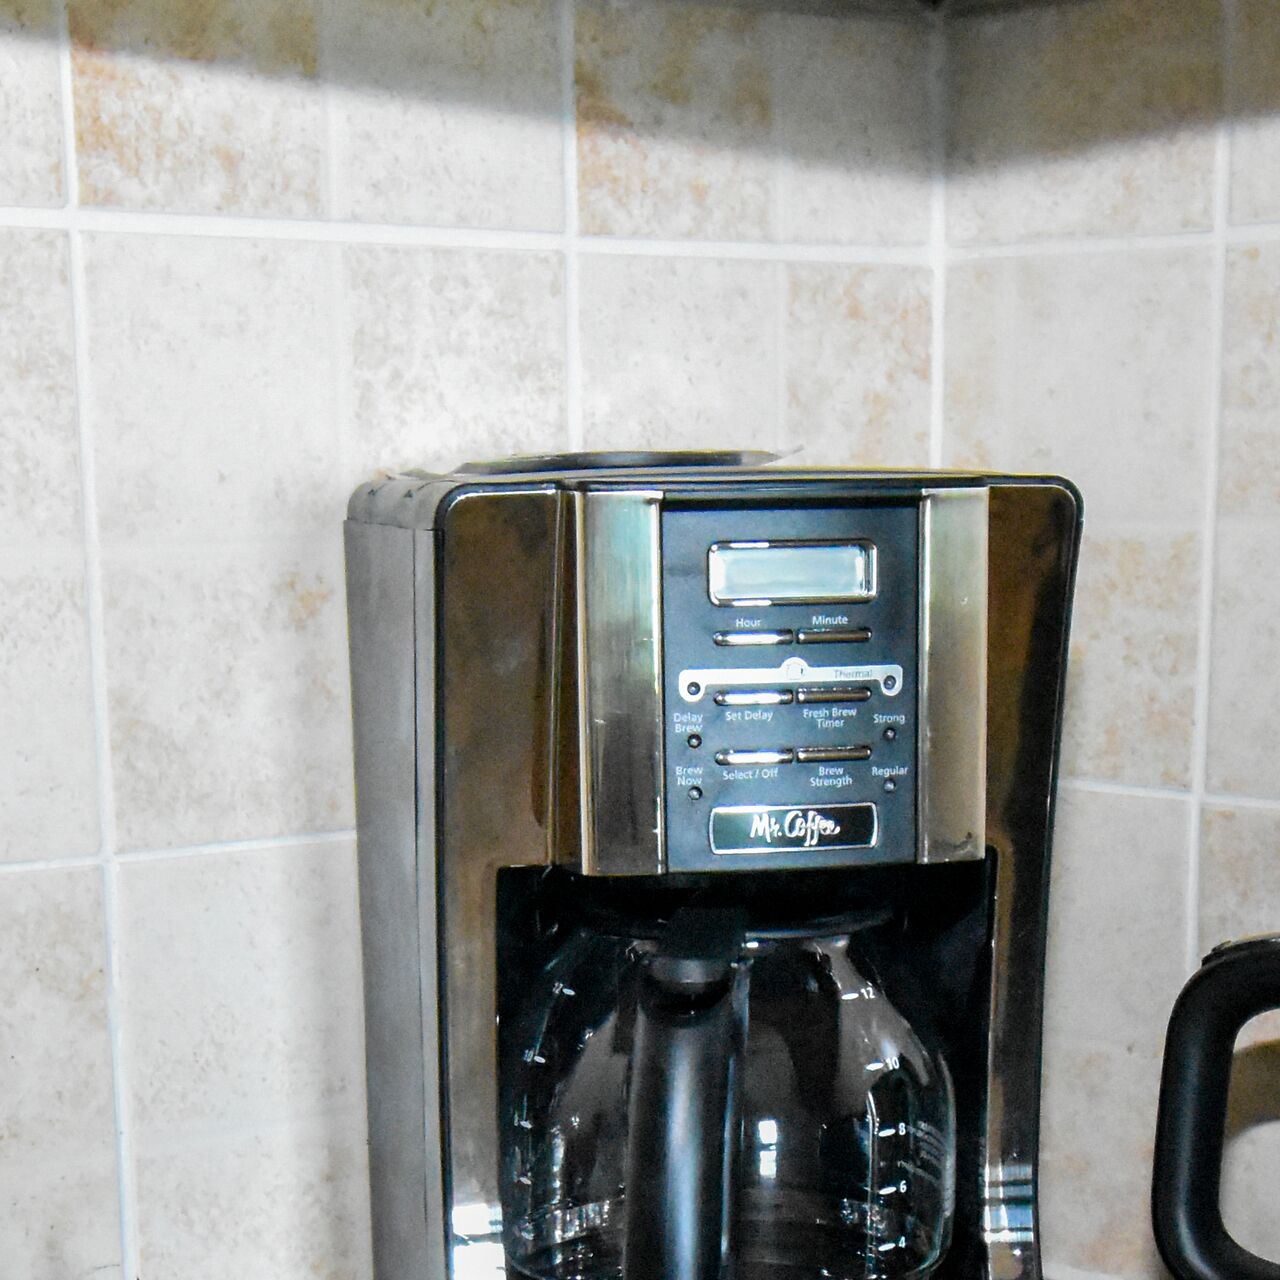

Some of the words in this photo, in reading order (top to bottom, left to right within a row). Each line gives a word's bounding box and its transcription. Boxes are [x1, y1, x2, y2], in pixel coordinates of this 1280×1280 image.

[735, 617, 761, 628] Hour
[812, 615, 848, 625] Minute
[833, 668, 872, 679] Thermal
[673, 712, 703, 724] Delay
[725, 710, 742, 721] Set
[744, 710, 774, 722] Delay
[803, 708, 830, 719] Fresh
[832, 707, 857, 718] Brew
[873, 713, 905, 725] Strong
[675, 723, 703, 733] Brew
[816, 717, 845, 729] Timer
[676, 766, 704, 776] Brew
[723, 770, 753, 780] Select
[761, 769, 778, 779] Off
[819, 766, 844, 776] Brew
[871, 766, 908, 777] Regular
[677, 776, 704, 786] Now
[809, 775, 853, 788] Strength
[750, 812, 783, 843] Mr.
[784, 811, 841, 846] Coffee
[861, 987, 875, 1000] 12
[886, 1056, 900, 1070] 10
[898, 1122, 906, 1135] 8
[899, 1180, 907, 1193] 6
[898, 1236, 906, 1249] 4
